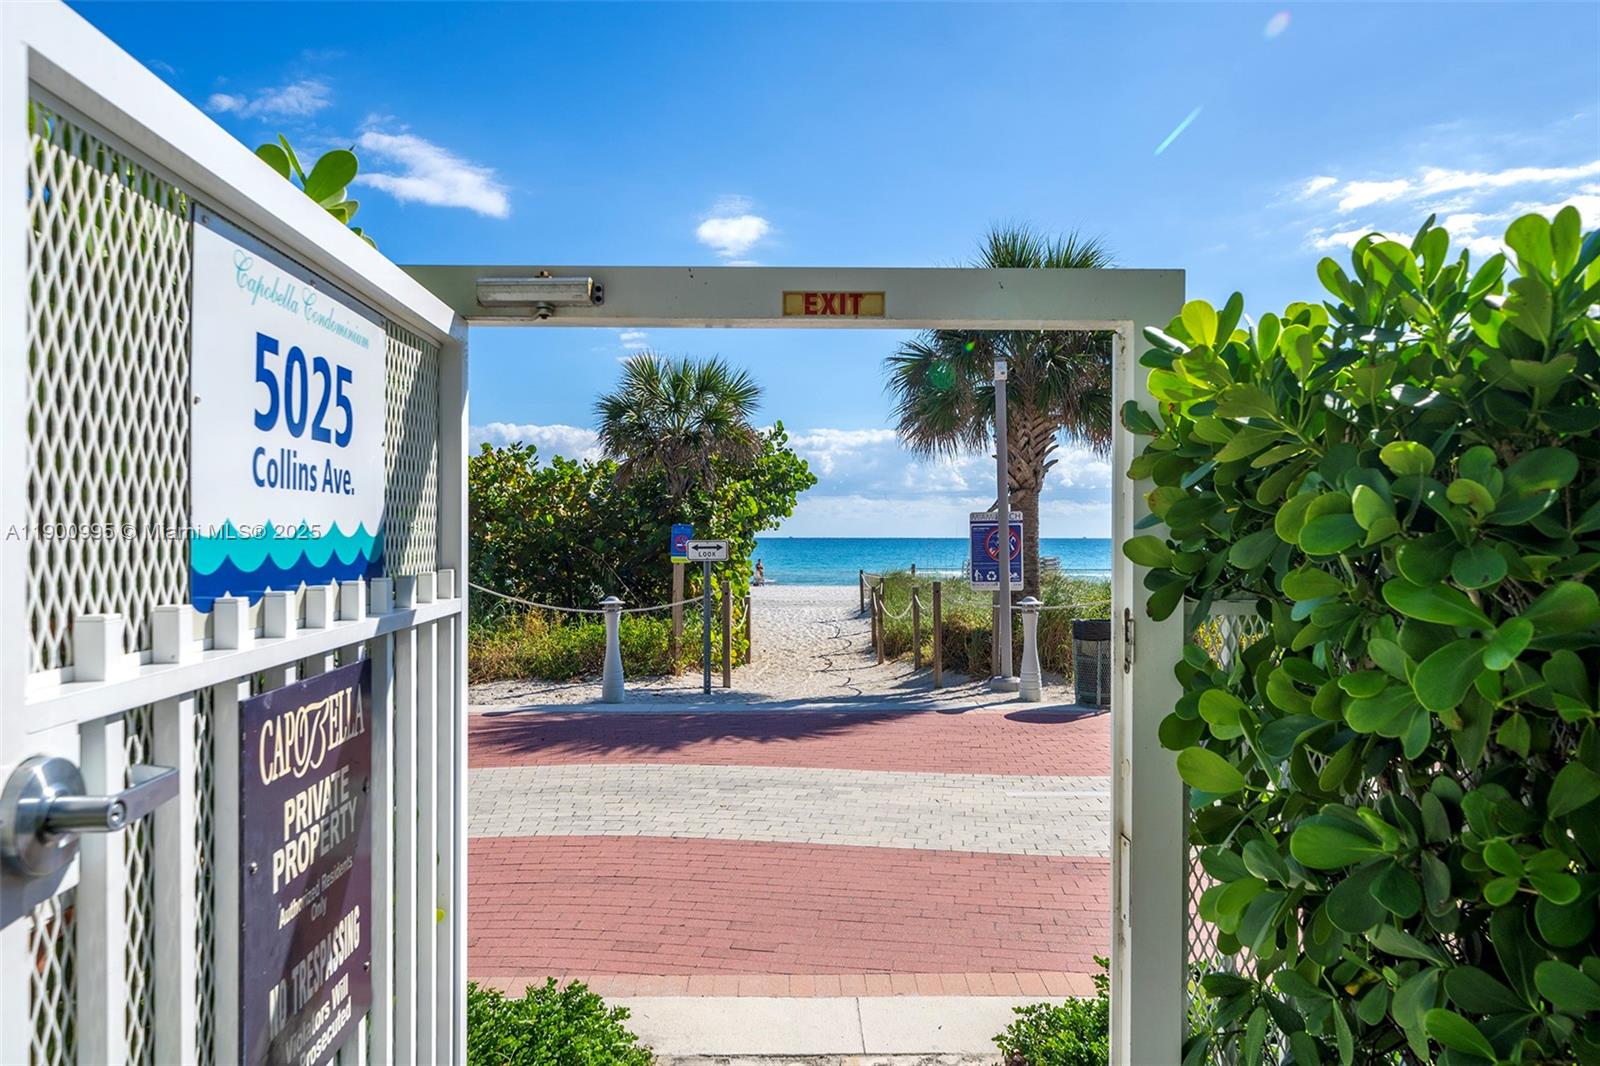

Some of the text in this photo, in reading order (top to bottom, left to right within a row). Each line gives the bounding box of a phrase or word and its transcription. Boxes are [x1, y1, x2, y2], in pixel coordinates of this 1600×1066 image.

[233, 249, 370, 350] Capobella Condominium
[804, 293, 864, 315] EXIT
[254, 331, 353, 449] 5025
[252, 446, 355, 496] Collins Ave.
[259, 683, 366, 786] CAPOBELLA
[272, 796, 358, 895] PROPERTY
[284, 764, 350, 842] PRIVATE
[311, 895, 327, 922] Only
[269, 904, 361, 1041] NO TRESPASSING
[285, 973, 349, 1065] Violators Will
